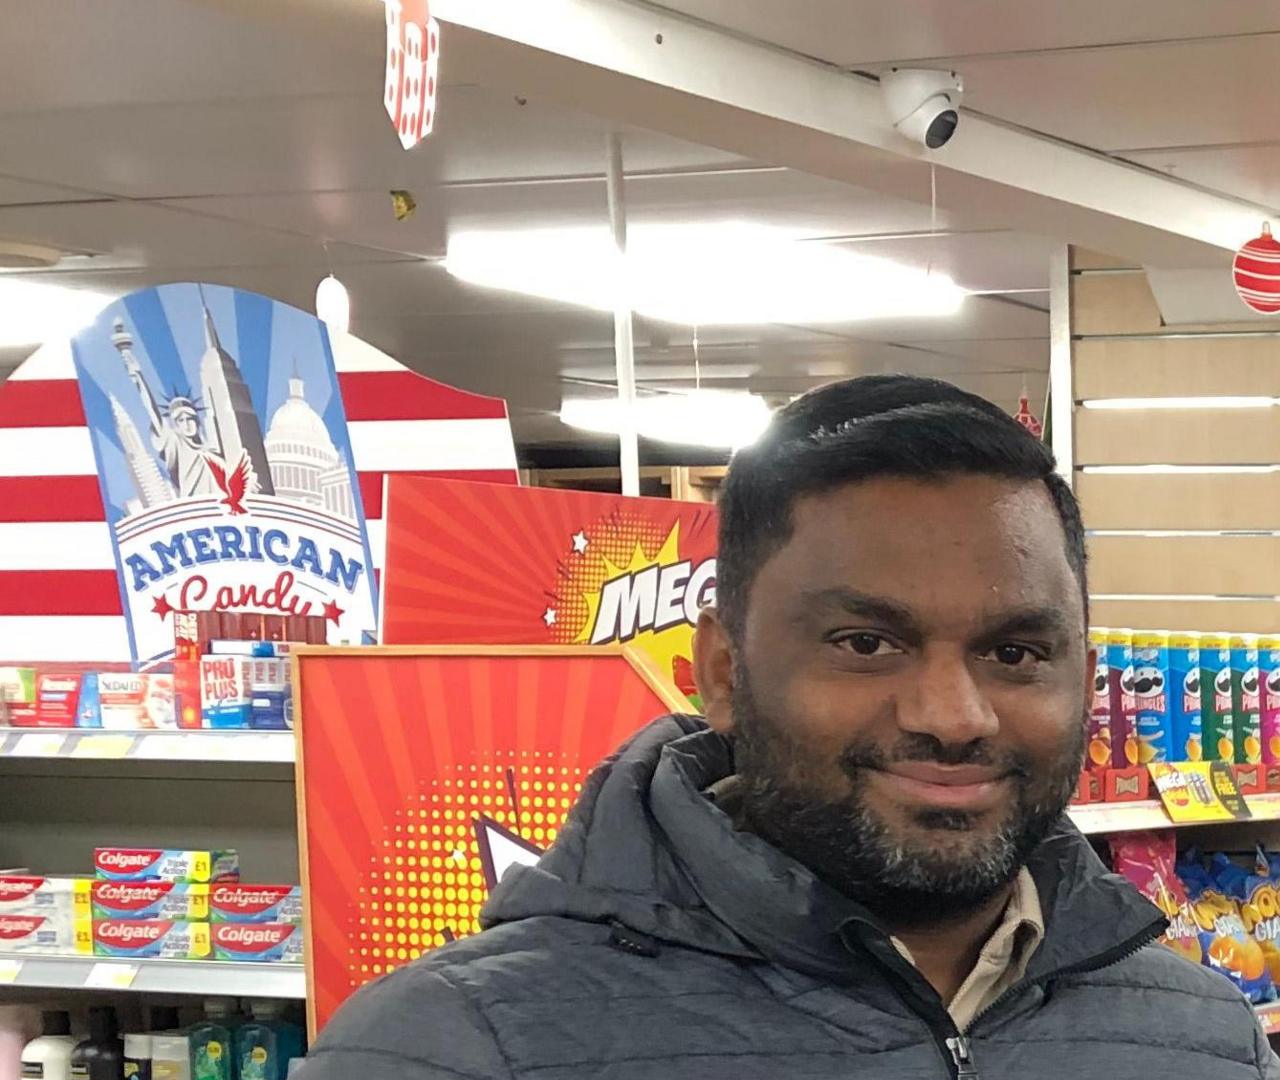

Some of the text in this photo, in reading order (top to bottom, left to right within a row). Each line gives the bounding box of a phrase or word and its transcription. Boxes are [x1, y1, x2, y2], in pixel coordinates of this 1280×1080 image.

[124, 525, 364, 593] AMERICAN
[180, 571, 313, 617] Candy
[204, 680, 239, 700] PLUS
[98, 852, 151, 868] Colgate
[97, 884, 159, 903] Colgate
[213, 887, 276, 906] Colgate
[76, 931, 90, 942] £1
[98, 923, 160, 941] Colgate
[218, 927, 281, 944] Colgate
